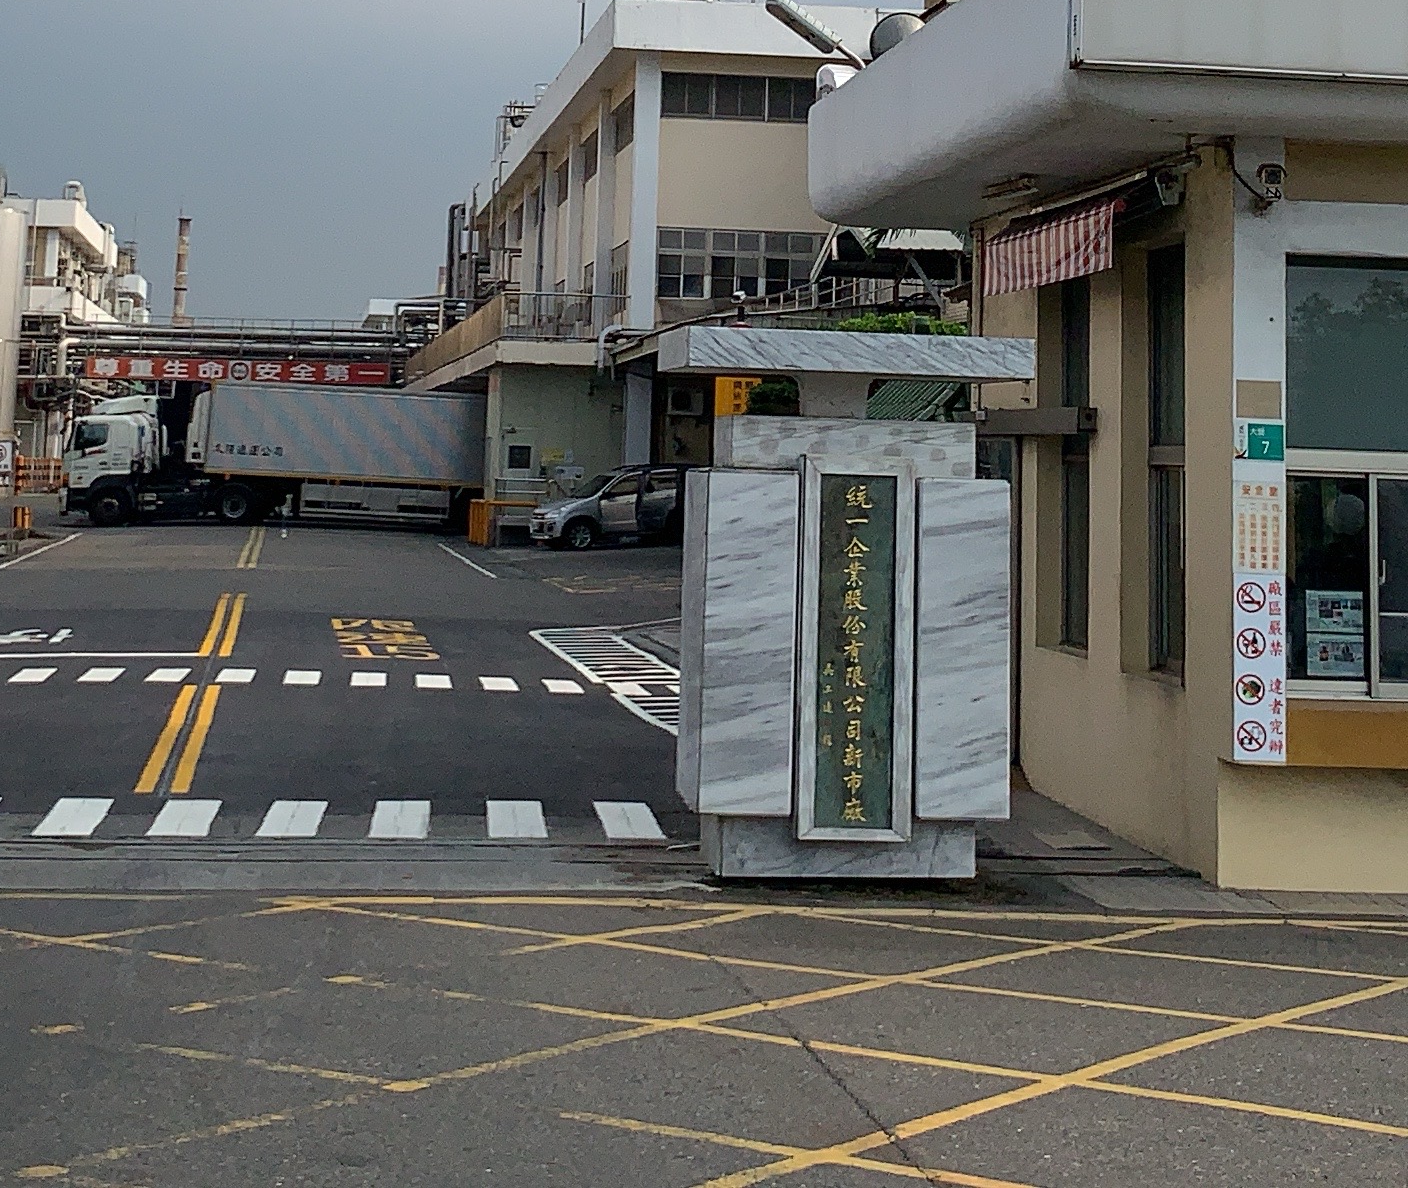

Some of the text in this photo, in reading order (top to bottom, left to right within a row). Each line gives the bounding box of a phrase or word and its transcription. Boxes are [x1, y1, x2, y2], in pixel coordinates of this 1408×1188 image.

[93, 358, 385, 382] 尊重生命 安全第一
[1261, 440, 1270, 454] 7
[842, 484, 874, 823] 統一企業股份有限公司新市廠
[1268, 579, 1284, 755] 廠區嚴禁 違者究辦
